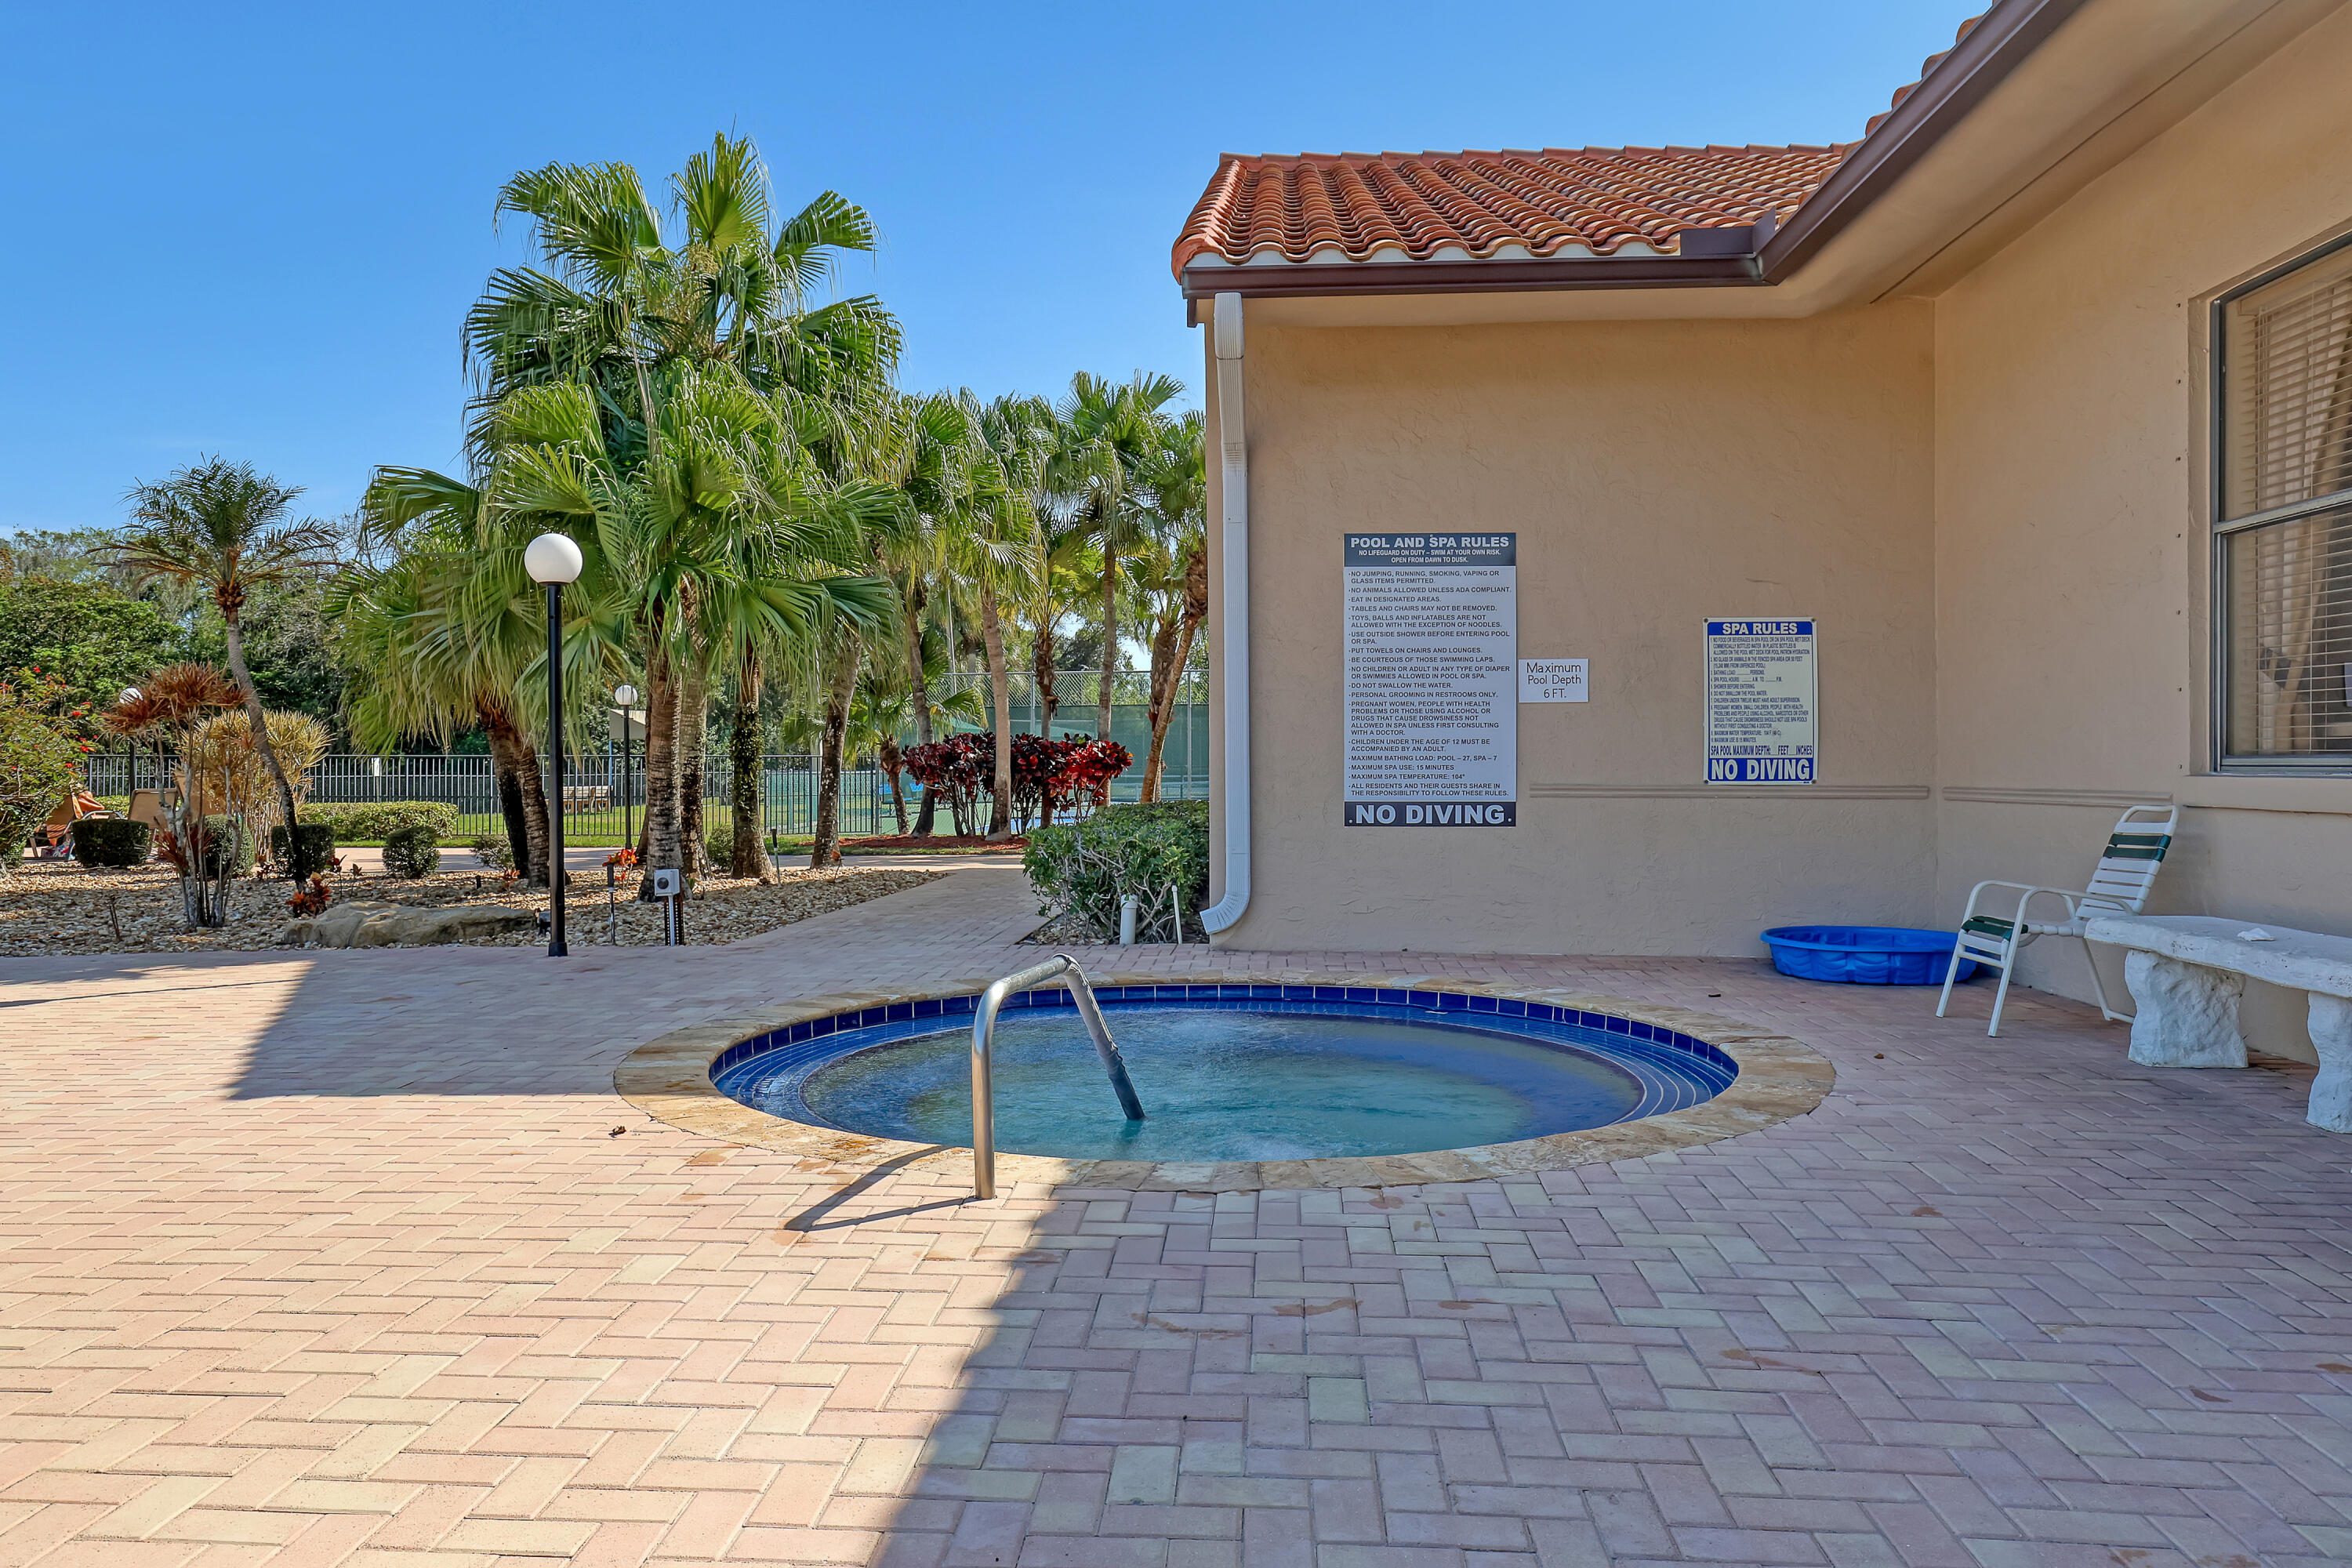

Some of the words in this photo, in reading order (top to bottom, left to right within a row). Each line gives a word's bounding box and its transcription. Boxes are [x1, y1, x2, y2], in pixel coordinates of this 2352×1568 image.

[1351, 537, 1389, 547] POOL
[1394, 537, 1425, 547] AND
[1429, 537, 1457, 547] SPA
[1461, 537, 1509, 547] RULES
[1722, 623, 1748, 634] SPA
[1753, 623, 1797, 634] RULES
[1526, 662, 1581, 673] Maximum
[1528, 674, 1548, 685] Pool
[1552, 674, 1581, 687] Depth
[1544, 688, 1549, 698] 6
[1552, 688, 1566, 698] FT.
[1720, 746, 1731, 756] POOL
[1733, 746, 1754, 756] MAXIMUM
[1711, 759, 1739, 780] NO
[1746, 759, 1809, 780] DIVING
[1356, 804, 1397, 824] NO
[1406, 804, 1504, 824] DIVING
